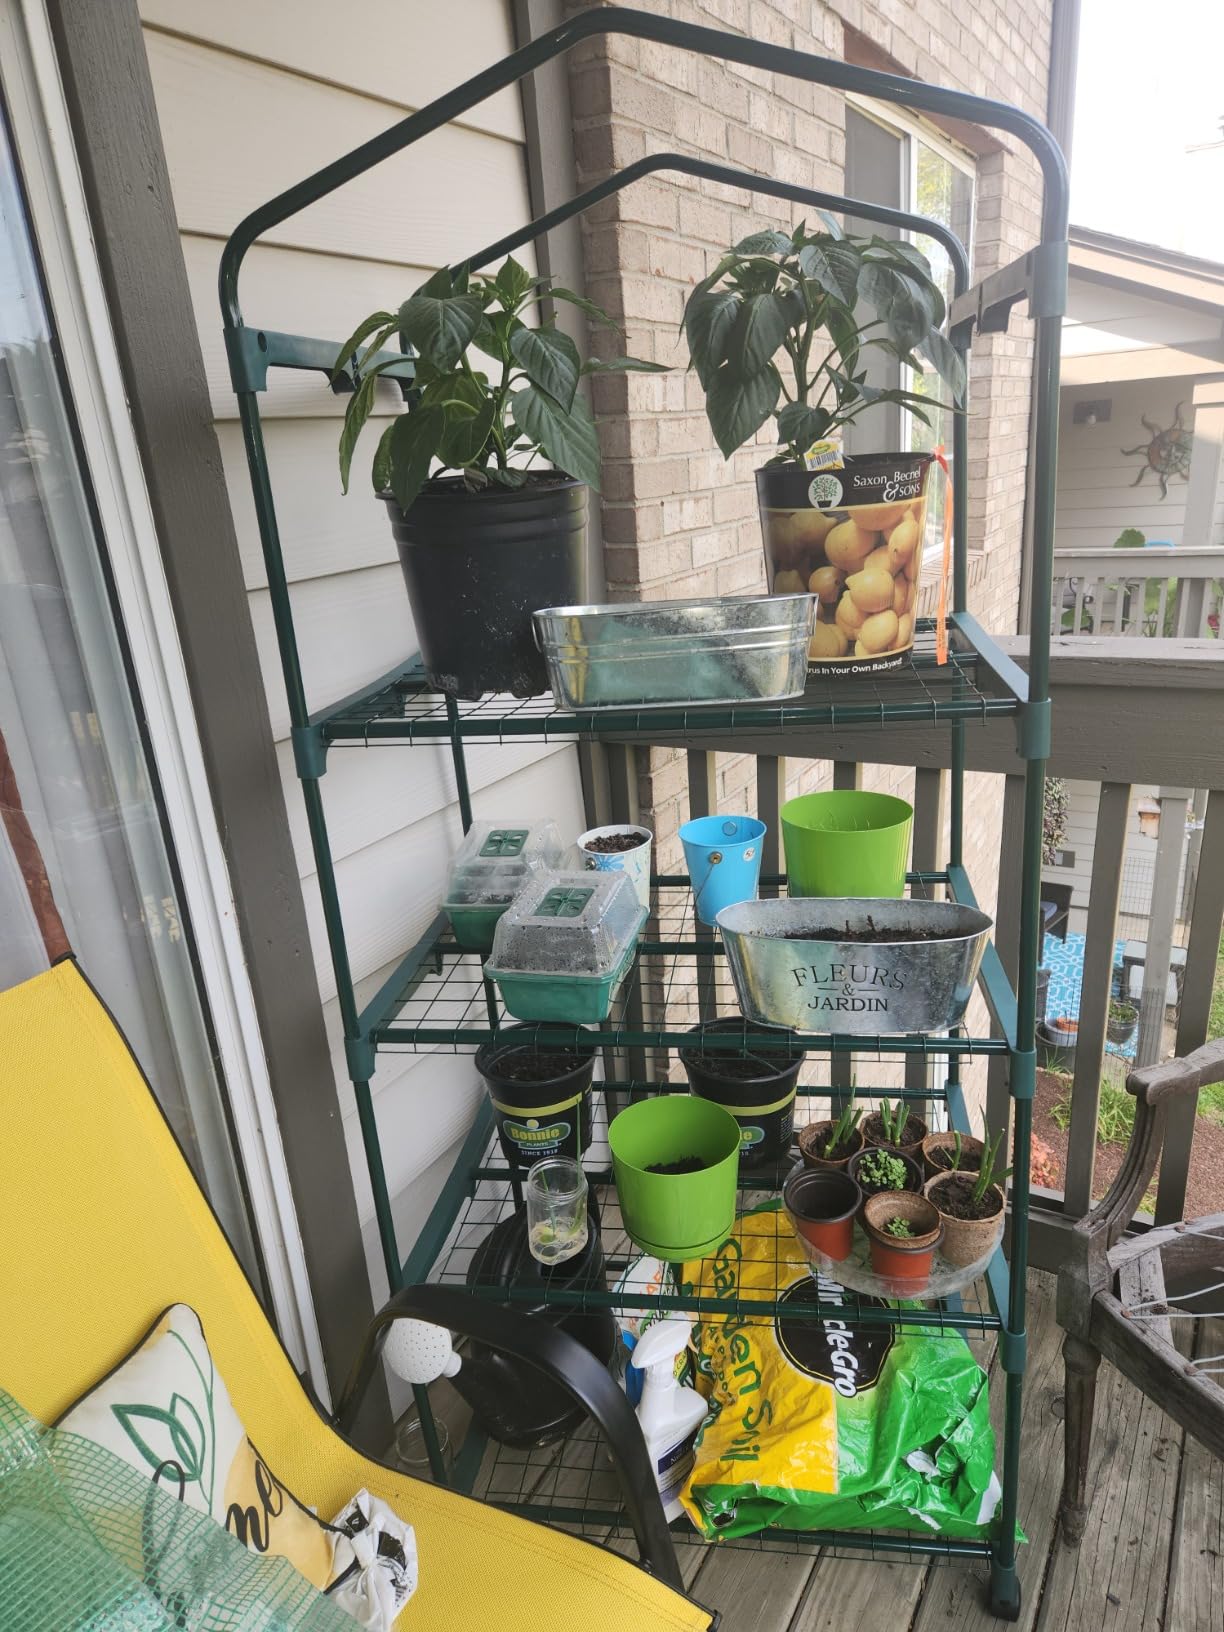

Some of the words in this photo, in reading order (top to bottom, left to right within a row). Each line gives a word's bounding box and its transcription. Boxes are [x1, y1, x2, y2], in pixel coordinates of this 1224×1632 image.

[853, 475, 887, 487] Saxon
[894, 465, 920, 482] Becnel
[882, 481, 900, 503] &
[899, 483, 920, 497] SONS
[830, 666, 850, 674] Your
[851, 665, 871, 673] Own
[791, 963, 908, 991] FLEURS
[842, 983, 855, 996] &
[808, 996, 888, 1012] JARDIN
[511, 1127, 560, 1141] Bonnie
[808, 1260, 859, 1398] Mircle-Gro
